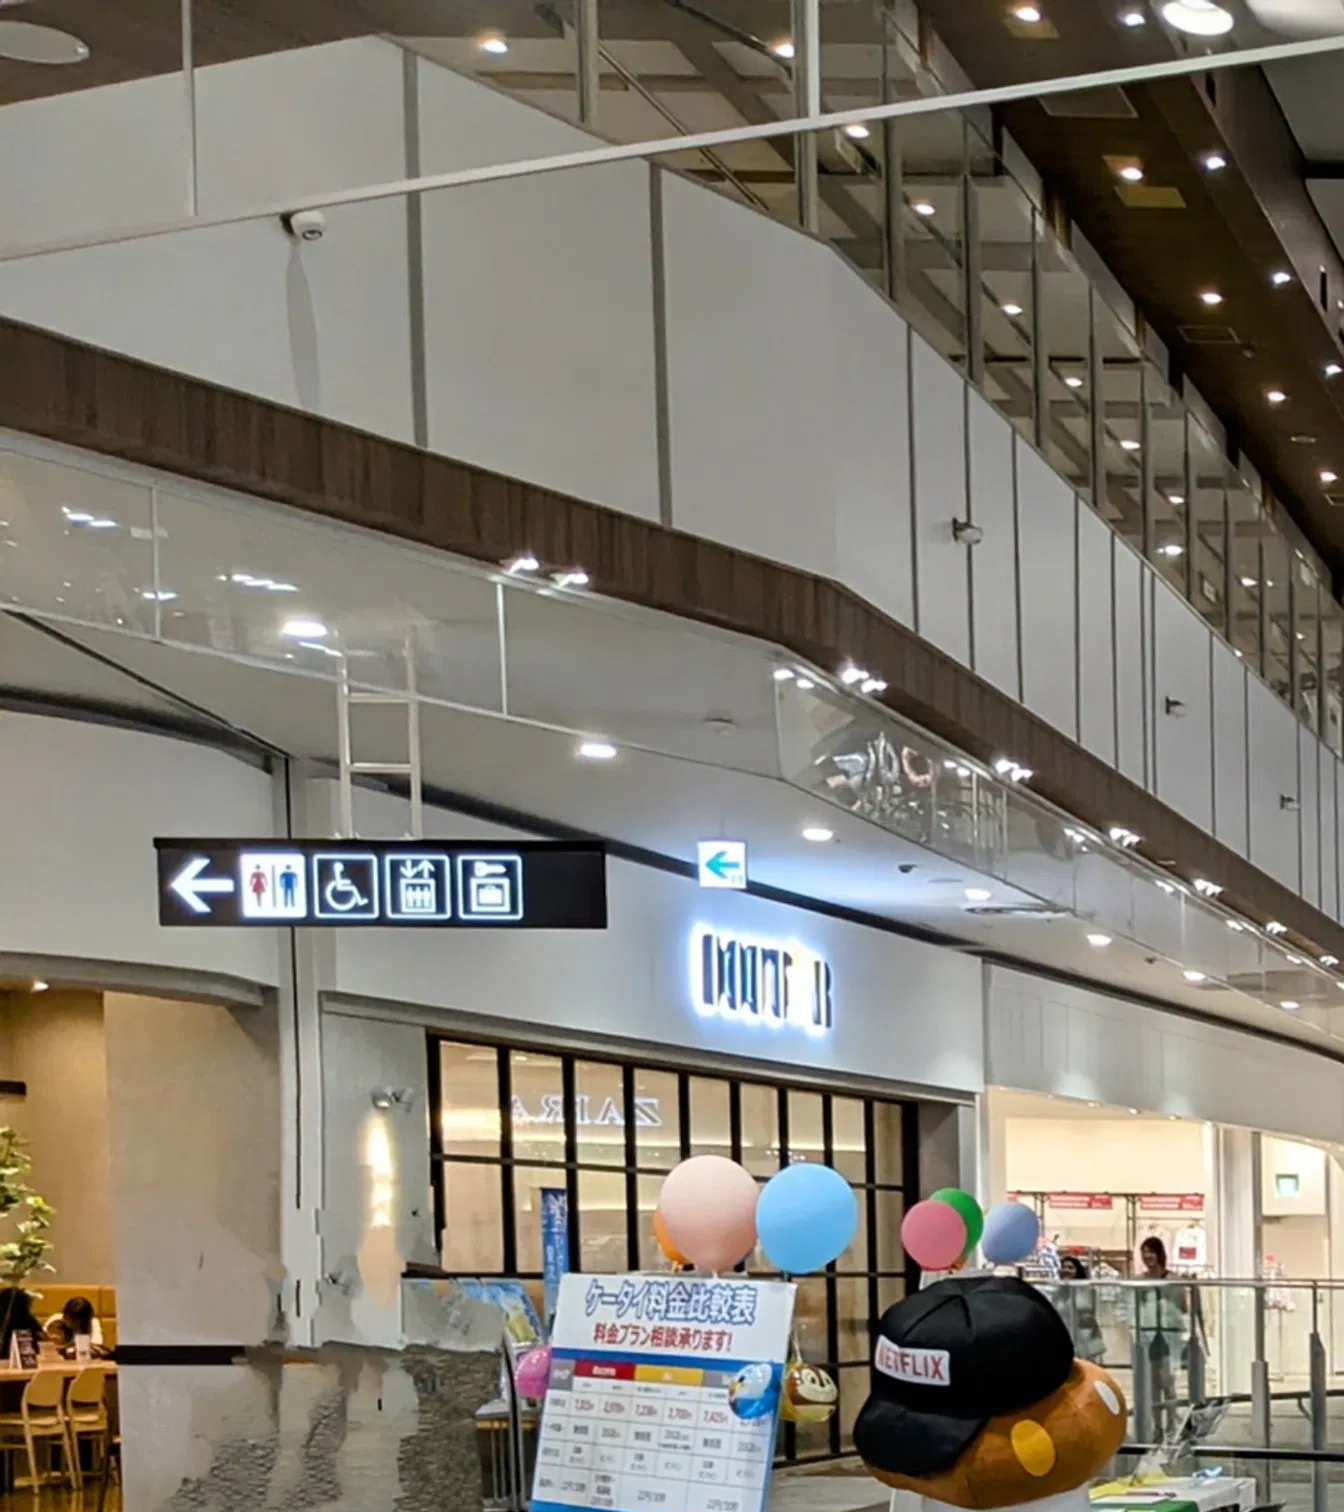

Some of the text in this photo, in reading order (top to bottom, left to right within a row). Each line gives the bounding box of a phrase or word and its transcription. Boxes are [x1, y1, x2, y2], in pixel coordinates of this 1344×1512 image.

[585, 1279, 757, 1325] ケータイ料金比較表
